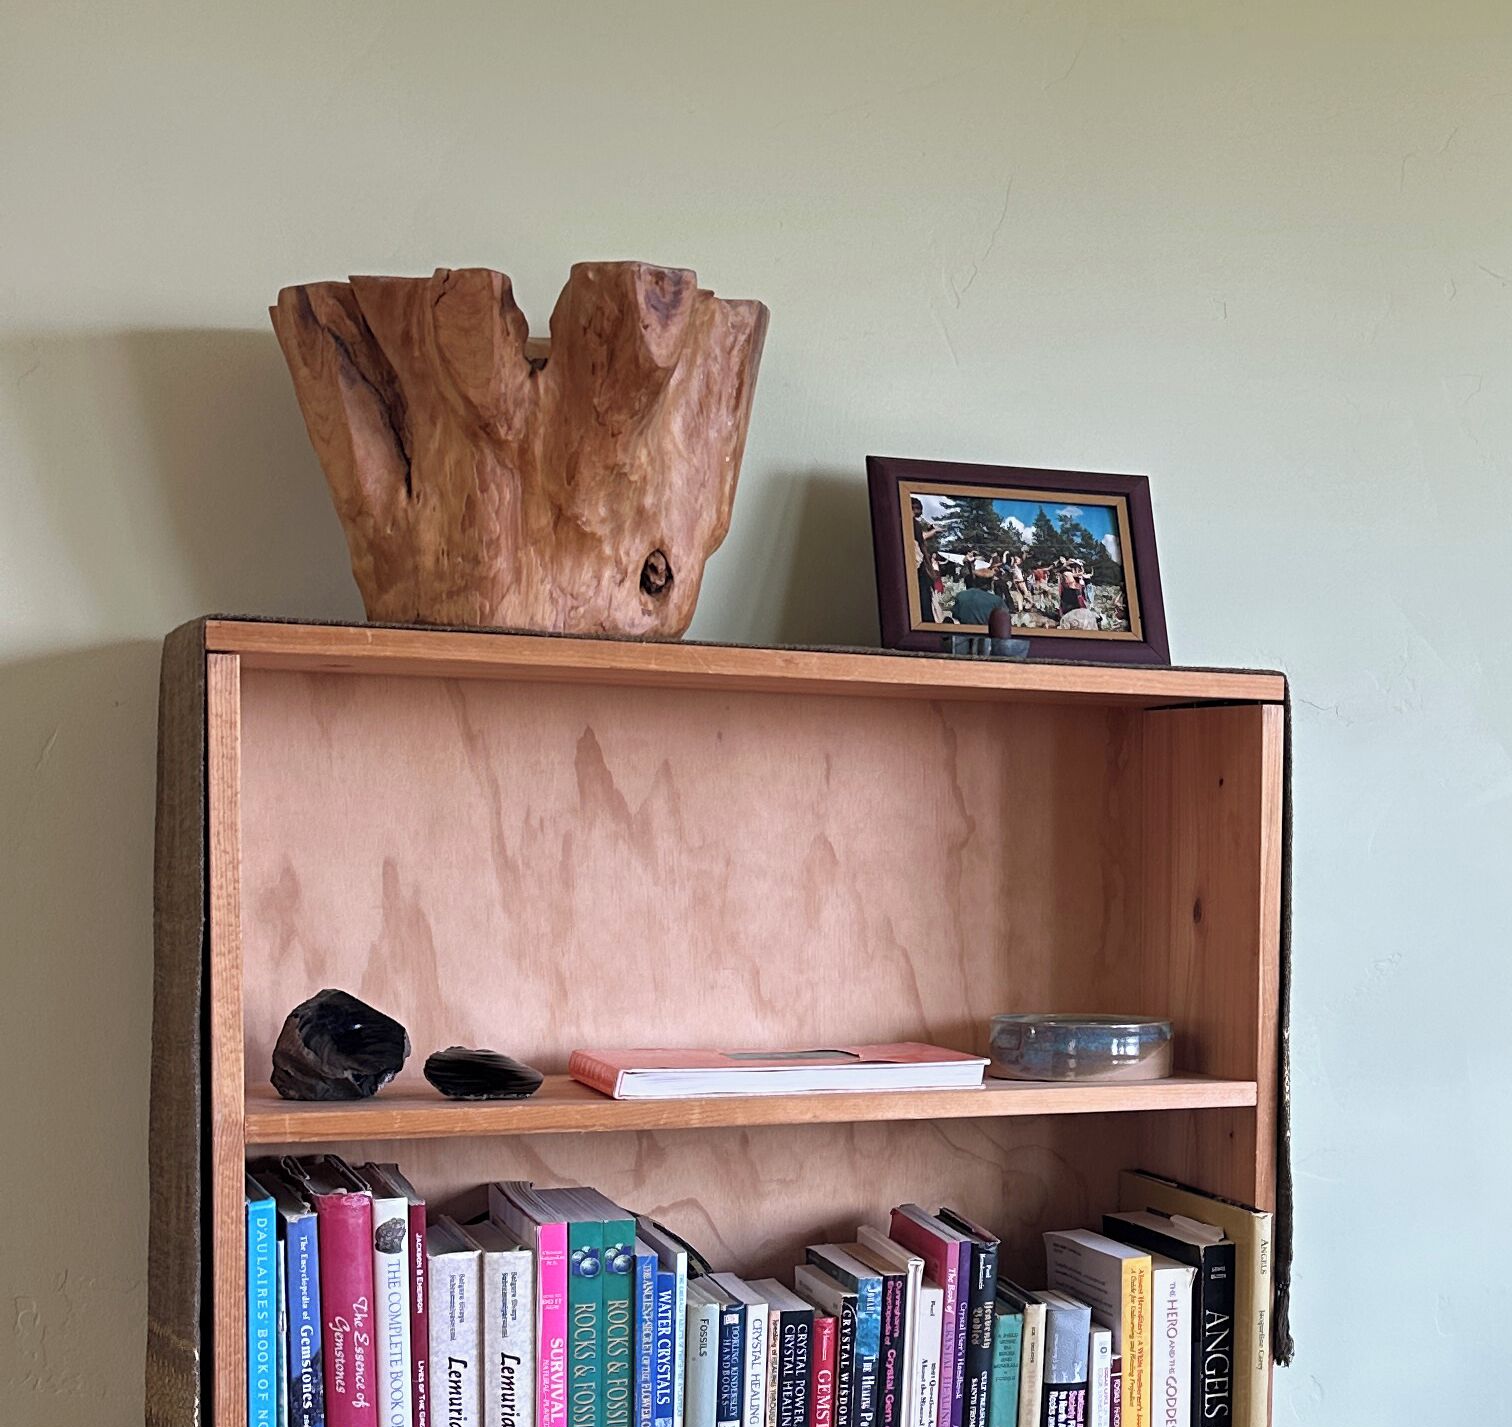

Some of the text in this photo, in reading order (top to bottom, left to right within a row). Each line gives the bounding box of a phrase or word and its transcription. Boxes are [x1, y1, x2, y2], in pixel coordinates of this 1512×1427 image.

[256, 1218, 268, 1324] D'AULAIRES'
[387, 1259, 401, 1290] THE
[946, 1284, 957, 1305] Book
[387, 1292, 404, 1358] COMPLETE
[573, 1302, 597, 1361] ROCKS
[606, 1299, 629, 1357] ROCKS
[656, 1289, 672, 1405] WATER CRYSTALS
[699, 1319, 710, 1358] FOSSILS
[1166, 1300, 1179, 1339] HERO
[257, 1329, 269, 1372] BOOK
[300, 1325, 314, 1409] Gemstones
[328, 1315, 351, 1395] Gemstones
[352, 1296, 370, 1409] The Essence of
[573, 1366, 596, 1378] &
[606, 1362, 628, 1376] &
[749, 1318, 763, 1426] CRYSTAL HEALING
[782, 1324, 796, 1377] CRYSTAL
[792, 1323, 808, 1427] CRYSTAL POWER,
[838, 1309, 852, 1426] CRYSTAL WISDOM
[1204, 1309, 1230, 1418] ANGELS
[257, 1380, 269, 1399] OF
[390, 1361, 405, 1409] BOOK
[883, 1394, 895, 1423] Gem
